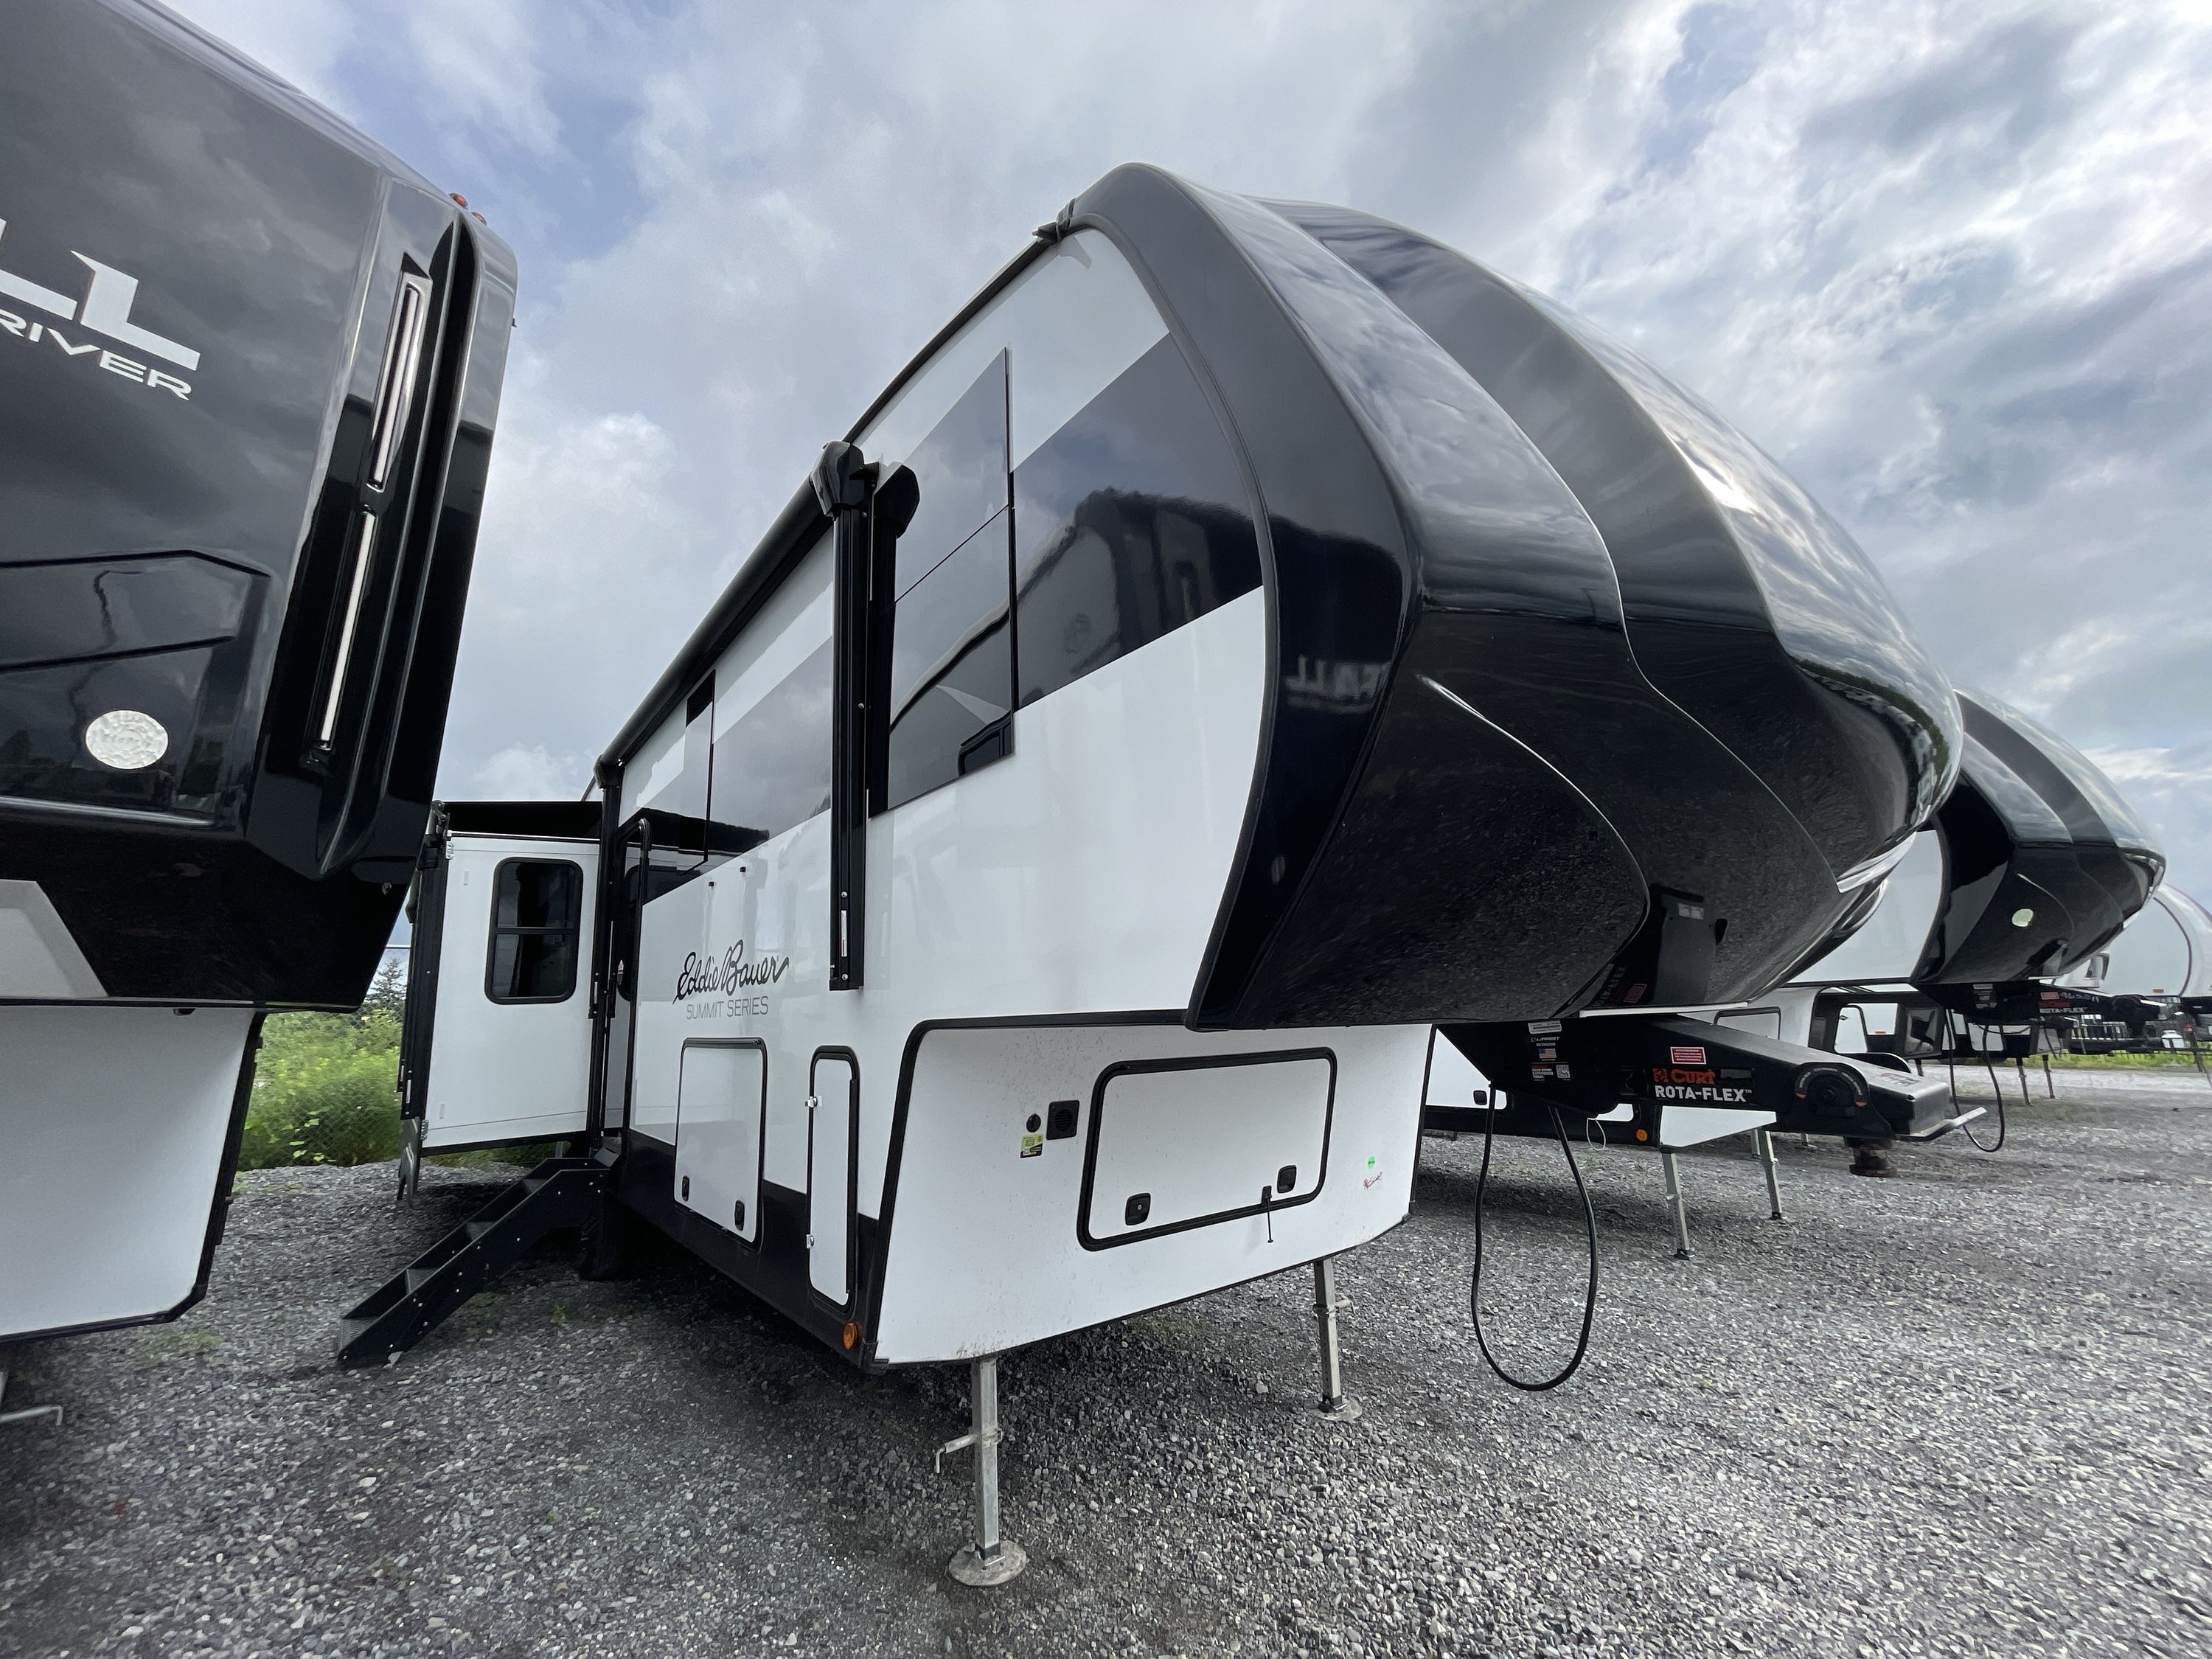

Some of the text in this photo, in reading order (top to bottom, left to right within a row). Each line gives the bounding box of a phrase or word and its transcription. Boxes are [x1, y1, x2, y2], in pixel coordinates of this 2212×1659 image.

[0, 308, 192, 400] RIVER
[672, 939, 790, 1005] Eddie Bauer
[686, 995, 769, 1020] SUMMIT SERIES
